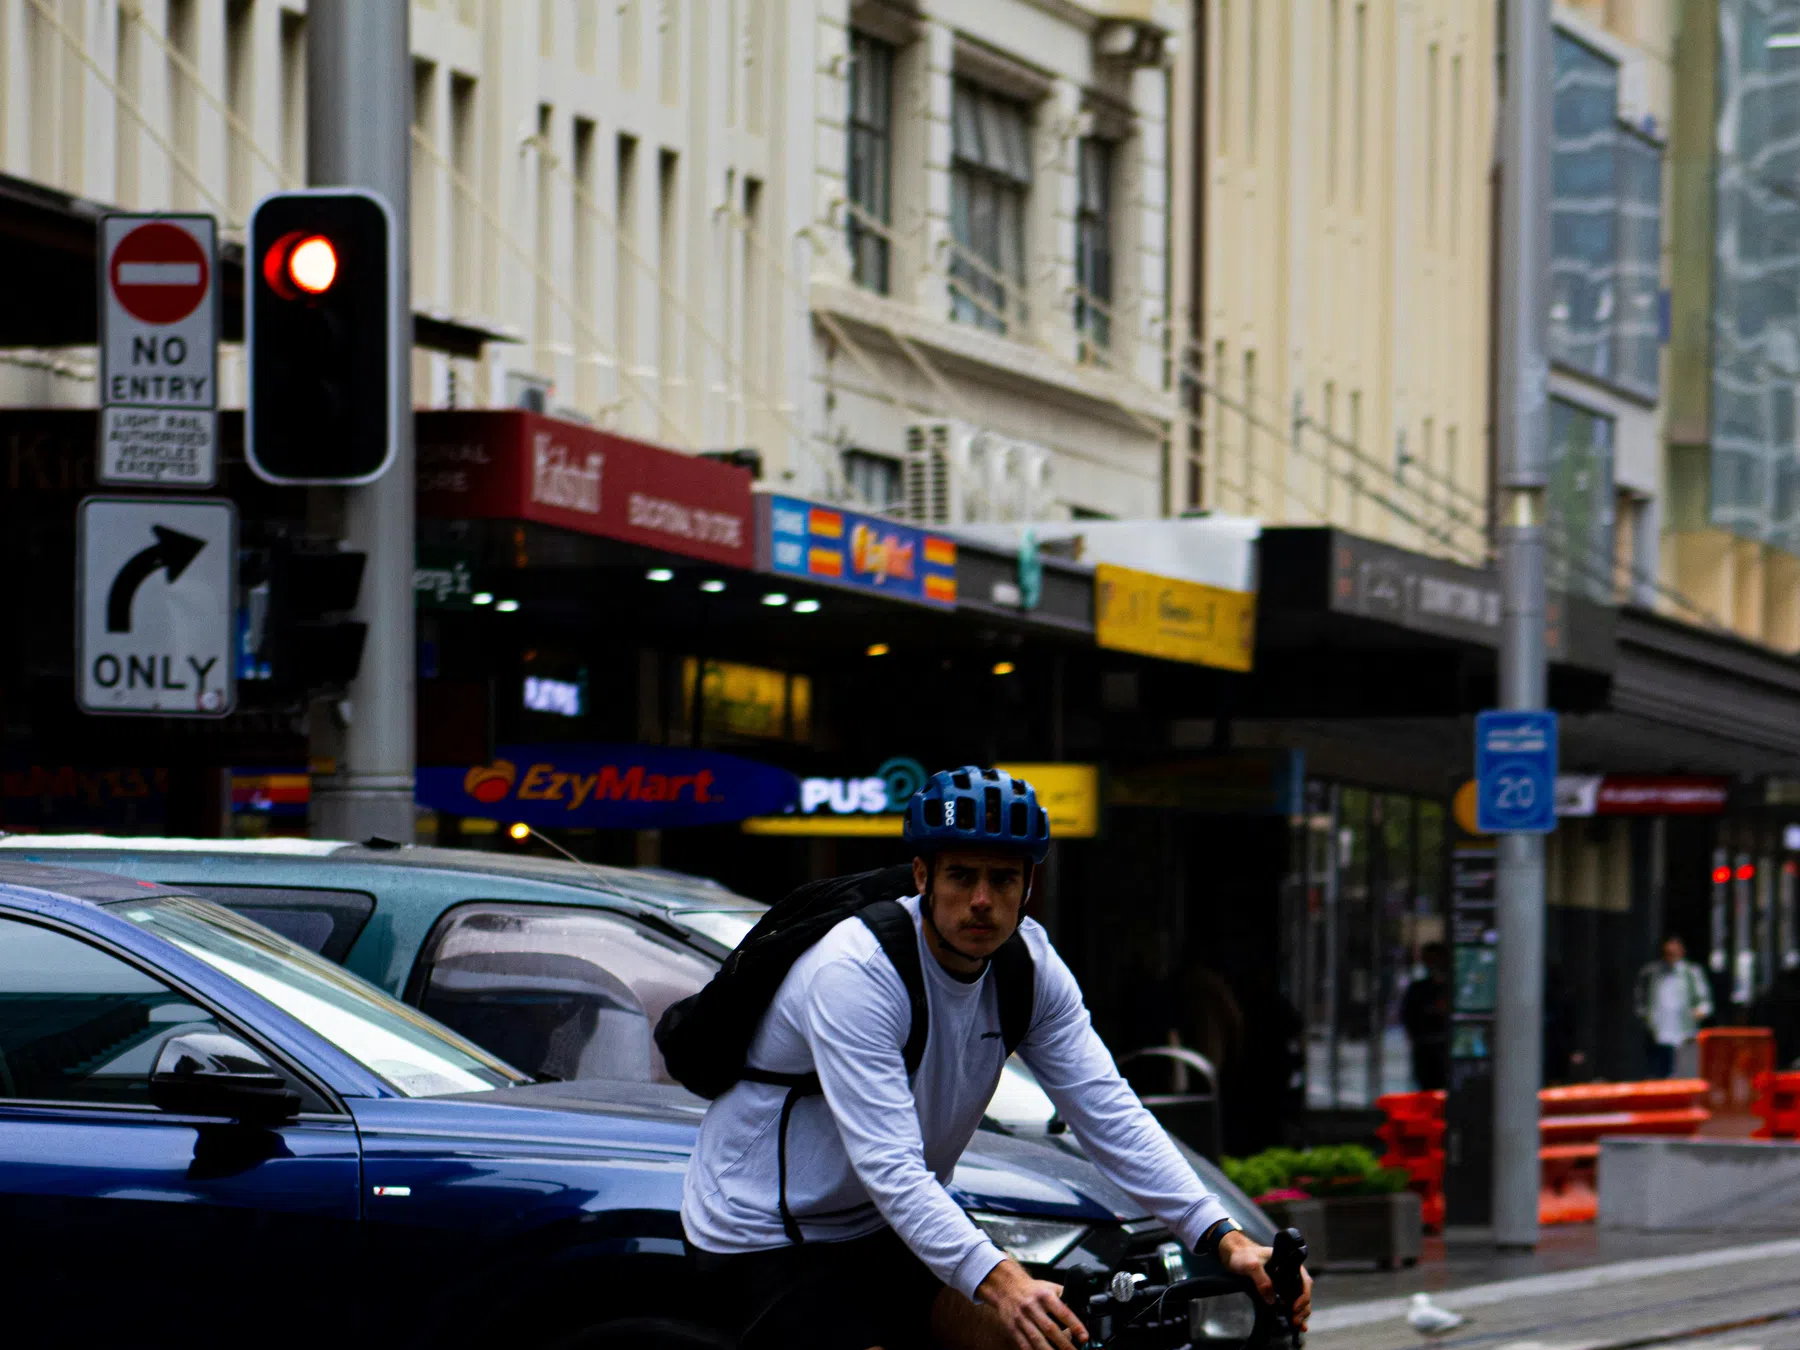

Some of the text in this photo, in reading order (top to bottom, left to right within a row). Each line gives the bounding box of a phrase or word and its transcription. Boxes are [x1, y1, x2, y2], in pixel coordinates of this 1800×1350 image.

[132, 335, 188, 366] NO
[111, 375, 208, 400] ENTRY
[93, 653, 219, 690] ONLY
[517, 762, 717, 811] EzyMart
[1496, 776, 1535, 809] 20
